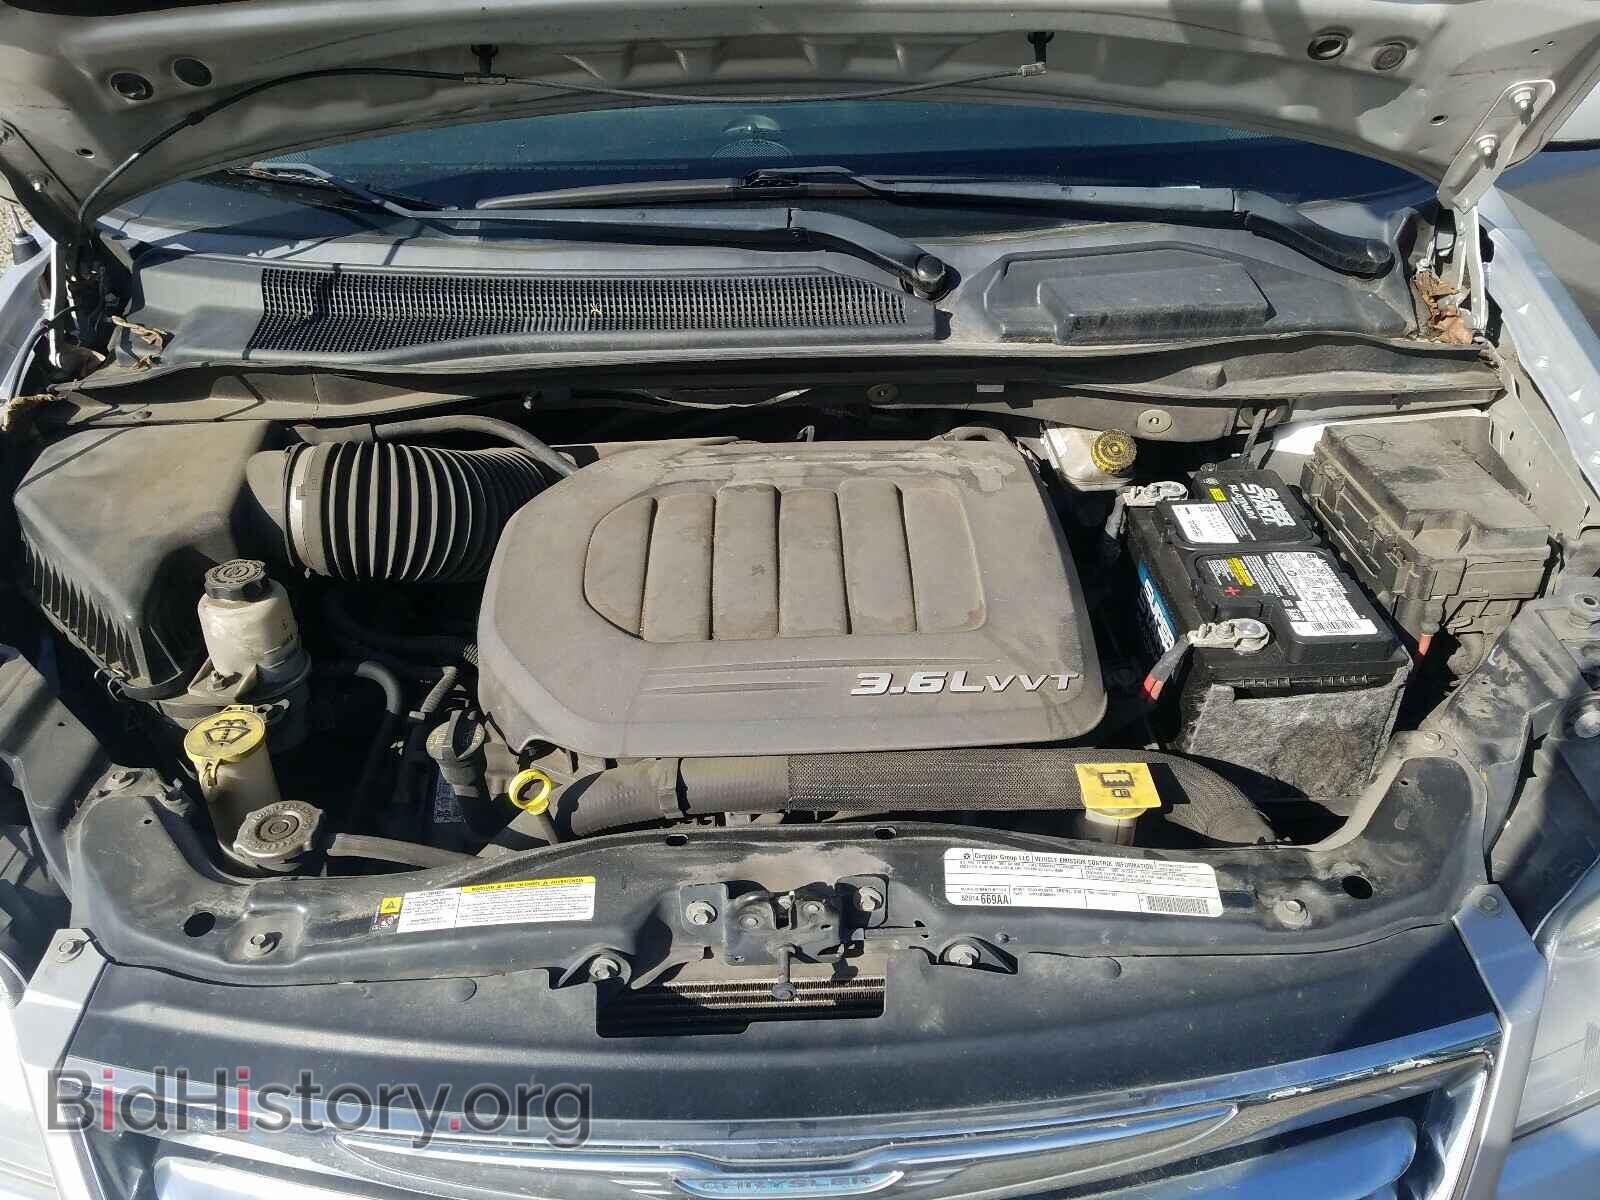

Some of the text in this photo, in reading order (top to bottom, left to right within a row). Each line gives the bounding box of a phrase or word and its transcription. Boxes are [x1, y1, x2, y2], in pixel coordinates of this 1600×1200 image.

[1263, 487, 1297, 527] SUPER
[1059, 857, 1086, 866] EMISSION
[1087, 859, 1112, 867] CONTROL
[1114, 860, 1154, 870] INFORMATION
